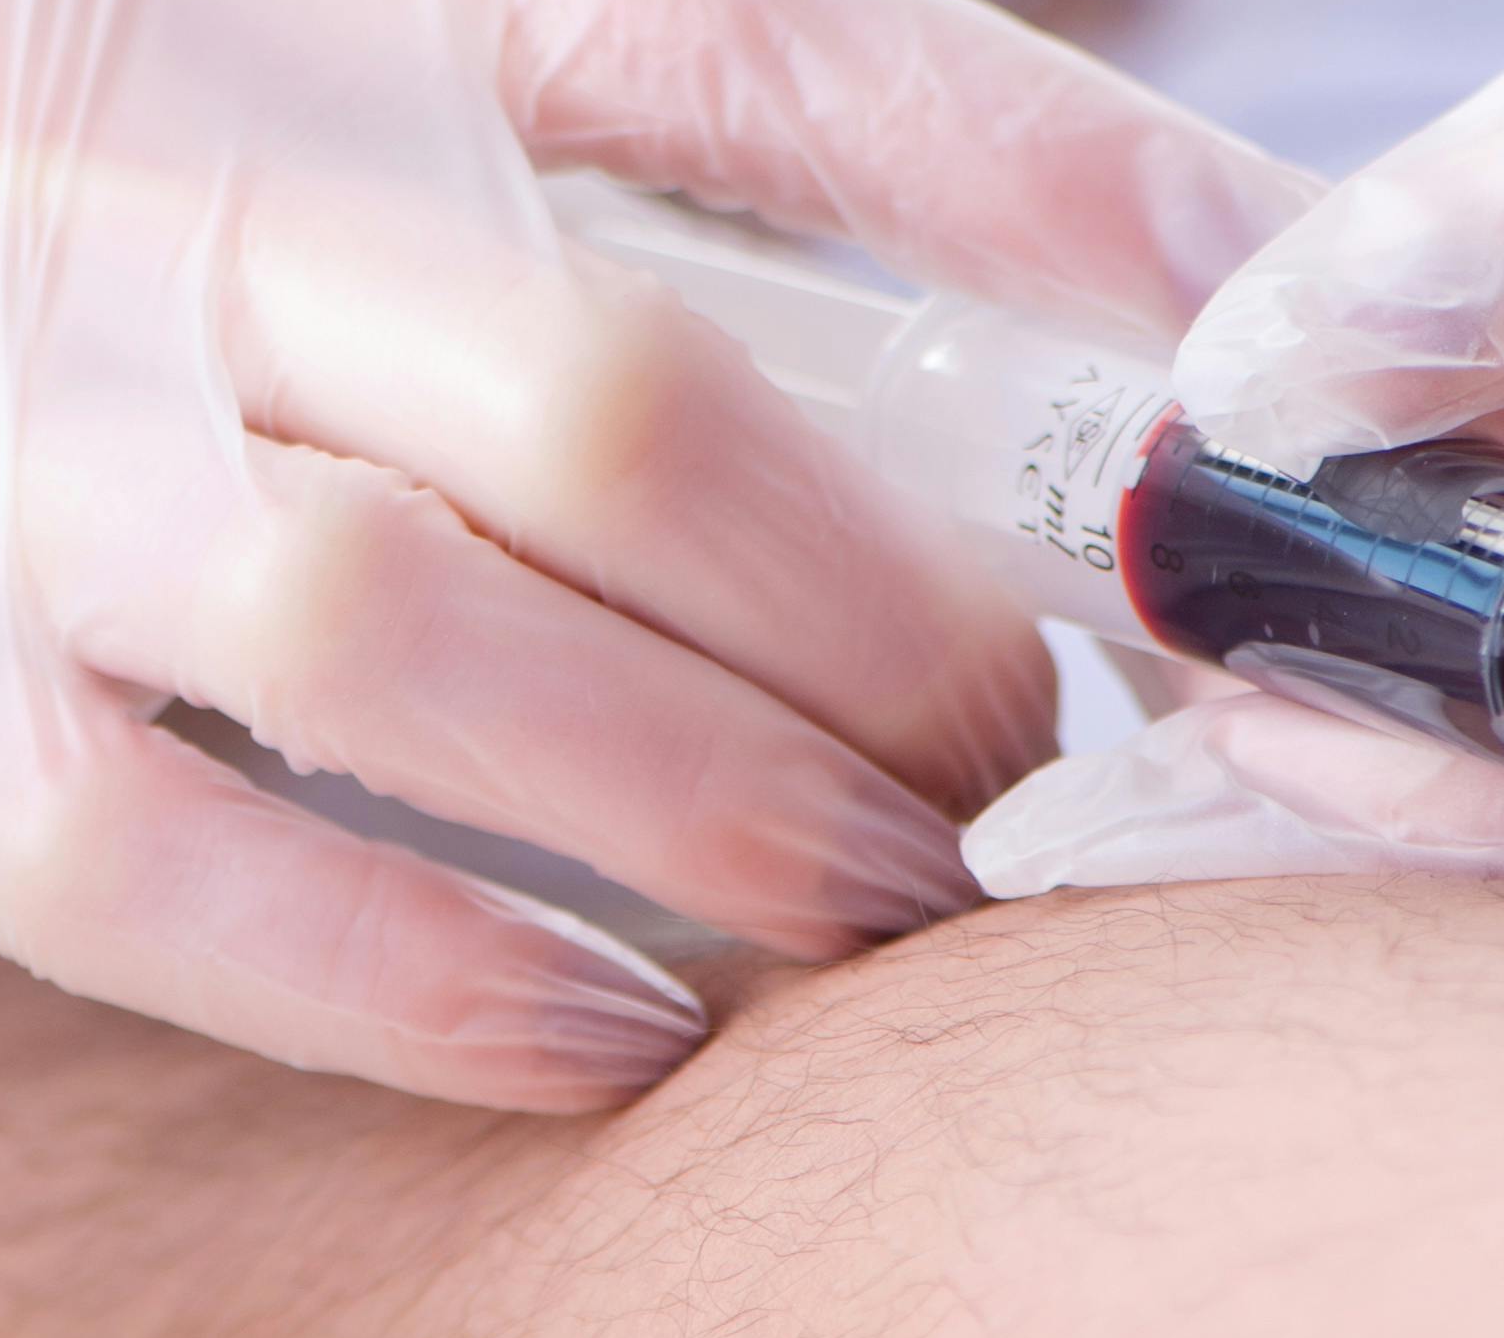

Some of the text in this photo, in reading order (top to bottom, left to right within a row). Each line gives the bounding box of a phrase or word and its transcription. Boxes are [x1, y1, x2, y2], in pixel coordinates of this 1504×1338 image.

[1043, 484, 1078, 560] ml
[1080, 524, 1114, 571] 10
[1150, 543, 1184, 573] 8
[1229, 570, 1262, 599] 6
